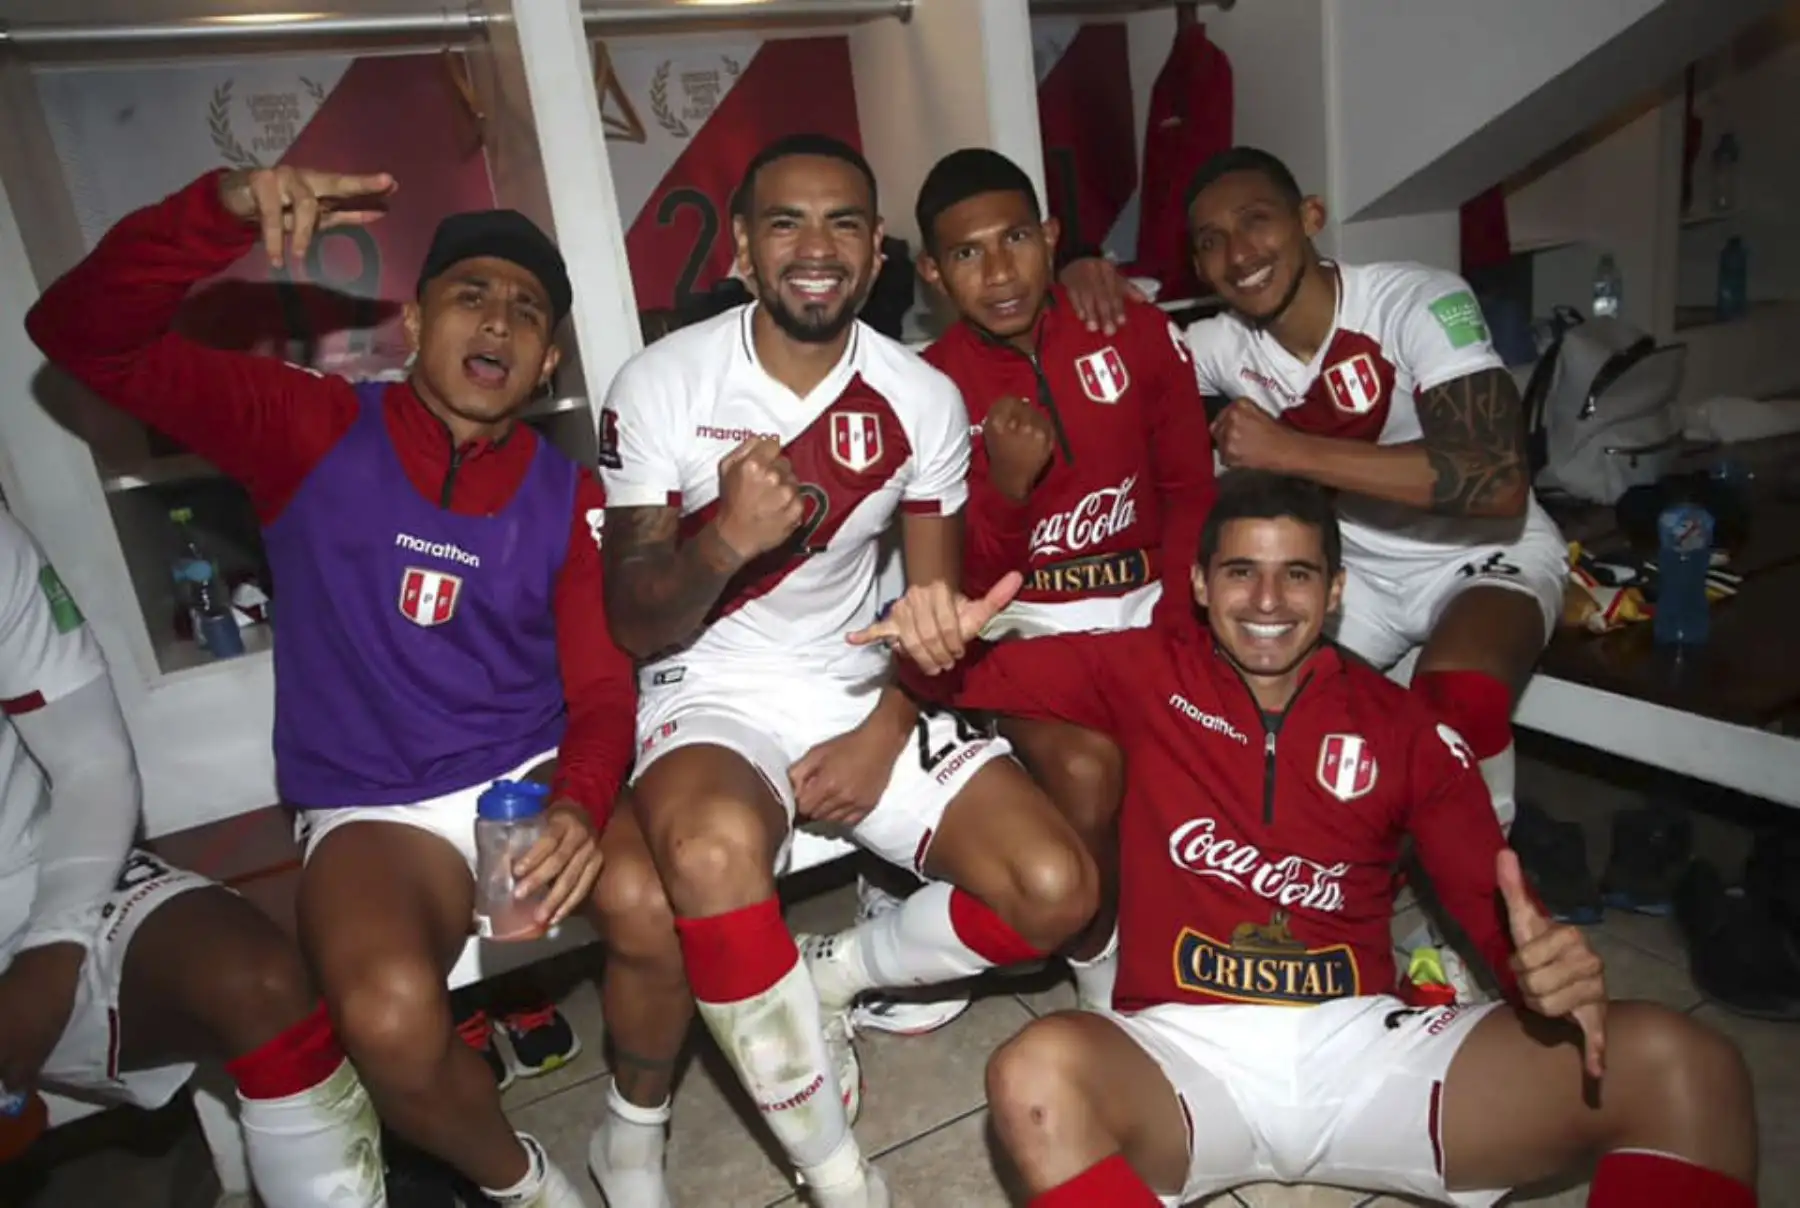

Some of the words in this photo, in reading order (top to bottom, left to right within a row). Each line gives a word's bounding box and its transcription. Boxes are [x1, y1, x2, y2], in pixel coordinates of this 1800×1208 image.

[395, 532, 480, 568] marathon
[1024, 557, 1136, 592] RISTAL
[1168, 693, 1248, 746] marathon
[1191, 944, 1344, 996] CRISTAL
